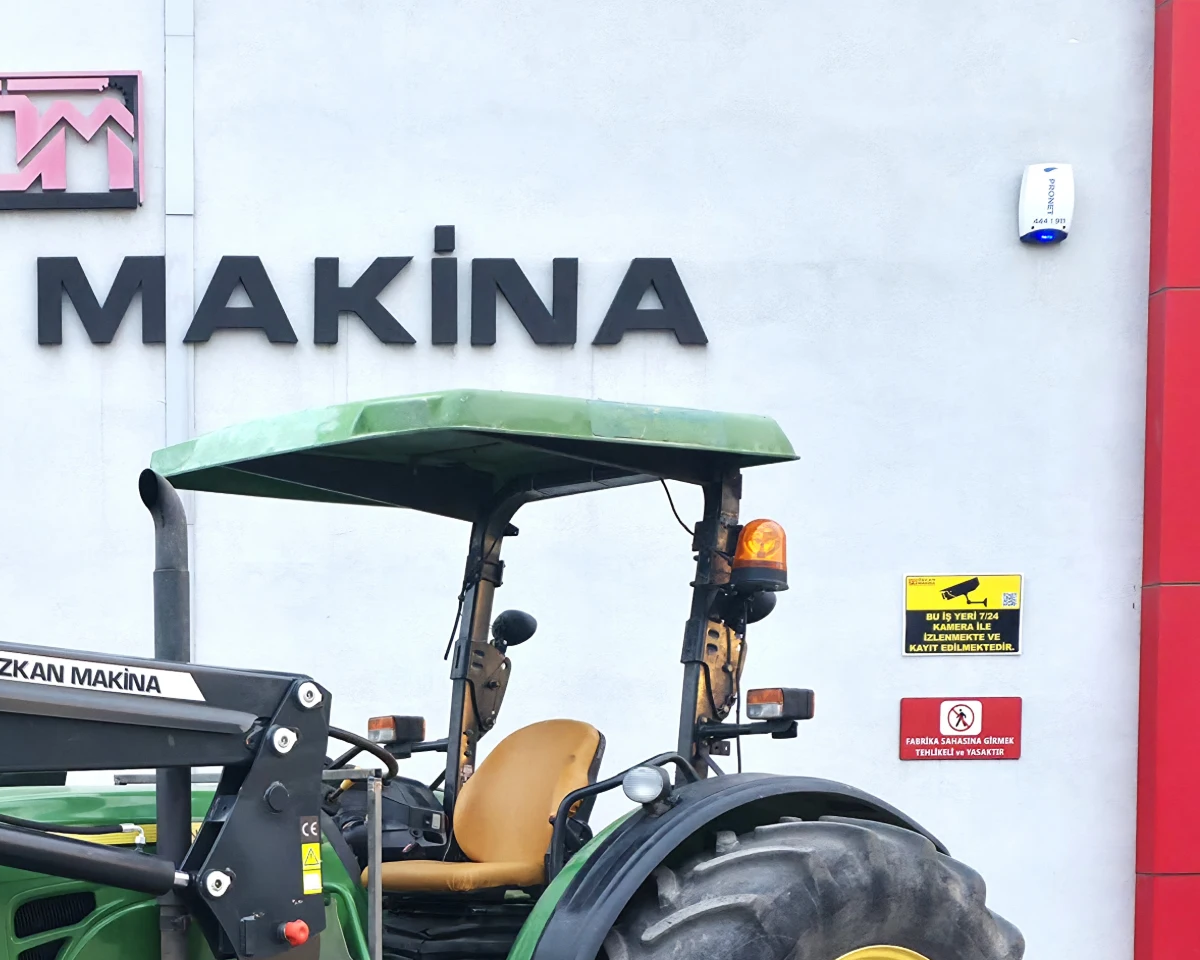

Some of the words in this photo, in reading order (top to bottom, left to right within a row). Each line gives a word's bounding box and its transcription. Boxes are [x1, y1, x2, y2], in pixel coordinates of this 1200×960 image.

[1047, 178, 1055, 215] PRONET
[37, 225, 708, 346] MAKİNA
[926, 613, 940, 621] BU
[942, 611, 952, 622] İŞ
[954, 611, 977, 620] YERİ
[979, 612, 999, 620] 7/24
[933, 623, 974, 631] KAMERA
[976, 621, 992, 631] İLE
[923, 632, 985, 641] İZLENMEKTE
[988, 633, 1001, 641] VE
[909, 644, 939, 652] KAYIT
[941, 642, 1015, 652] EDİLMEKTEDİR.
[70, 667, 161, 694] MAKİNA
[905, 736, 939, 745] FABRİKA
[941, 737, 982, 745] SAHASINA
[984, 736, 1015, 744] GİRMEK
[915, 747, 954, 756] TEHLİKELİ
[967, 748, 1005, 756] YASAKTIR
[302, 822, 318, 836] CE
